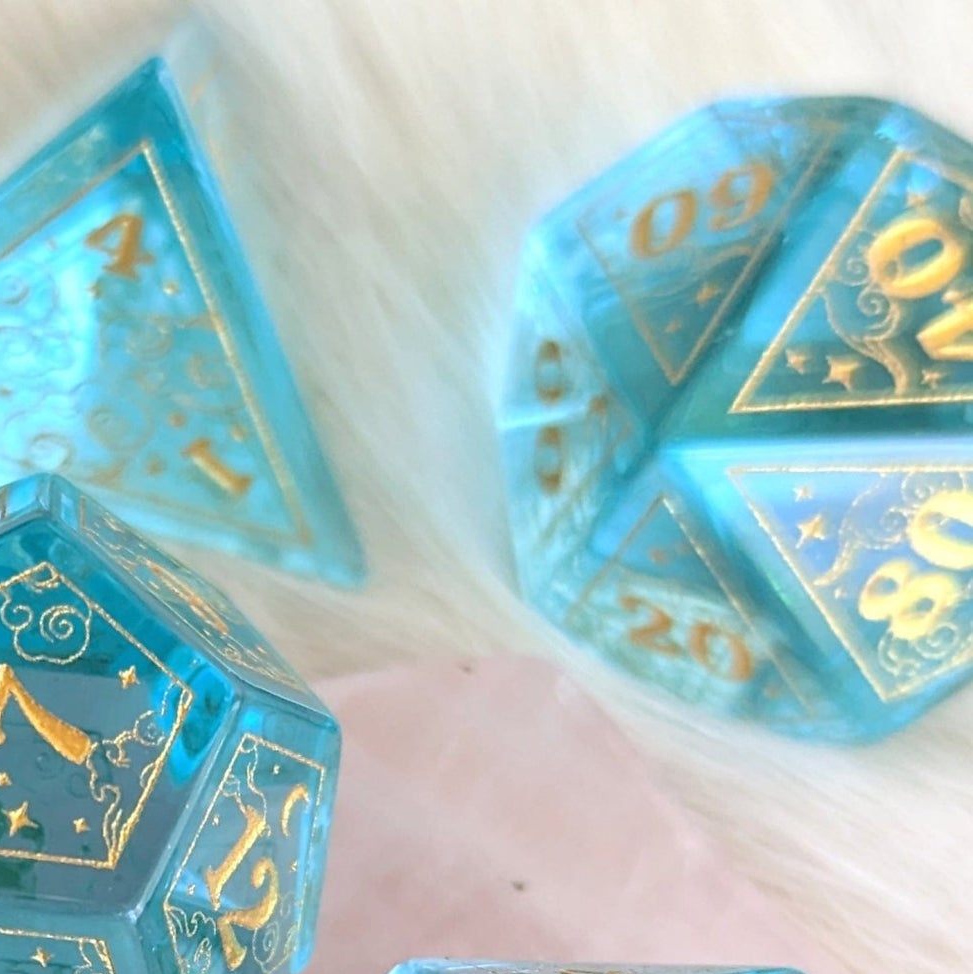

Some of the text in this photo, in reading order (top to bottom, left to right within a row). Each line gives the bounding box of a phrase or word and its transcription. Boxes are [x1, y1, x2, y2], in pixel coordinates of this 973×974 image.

[87, 213, 155, 281] 4
[182, 438, 254, 497] 1
[619, 594, 756, 685] 20
[205, 806, 279, 972] 12
